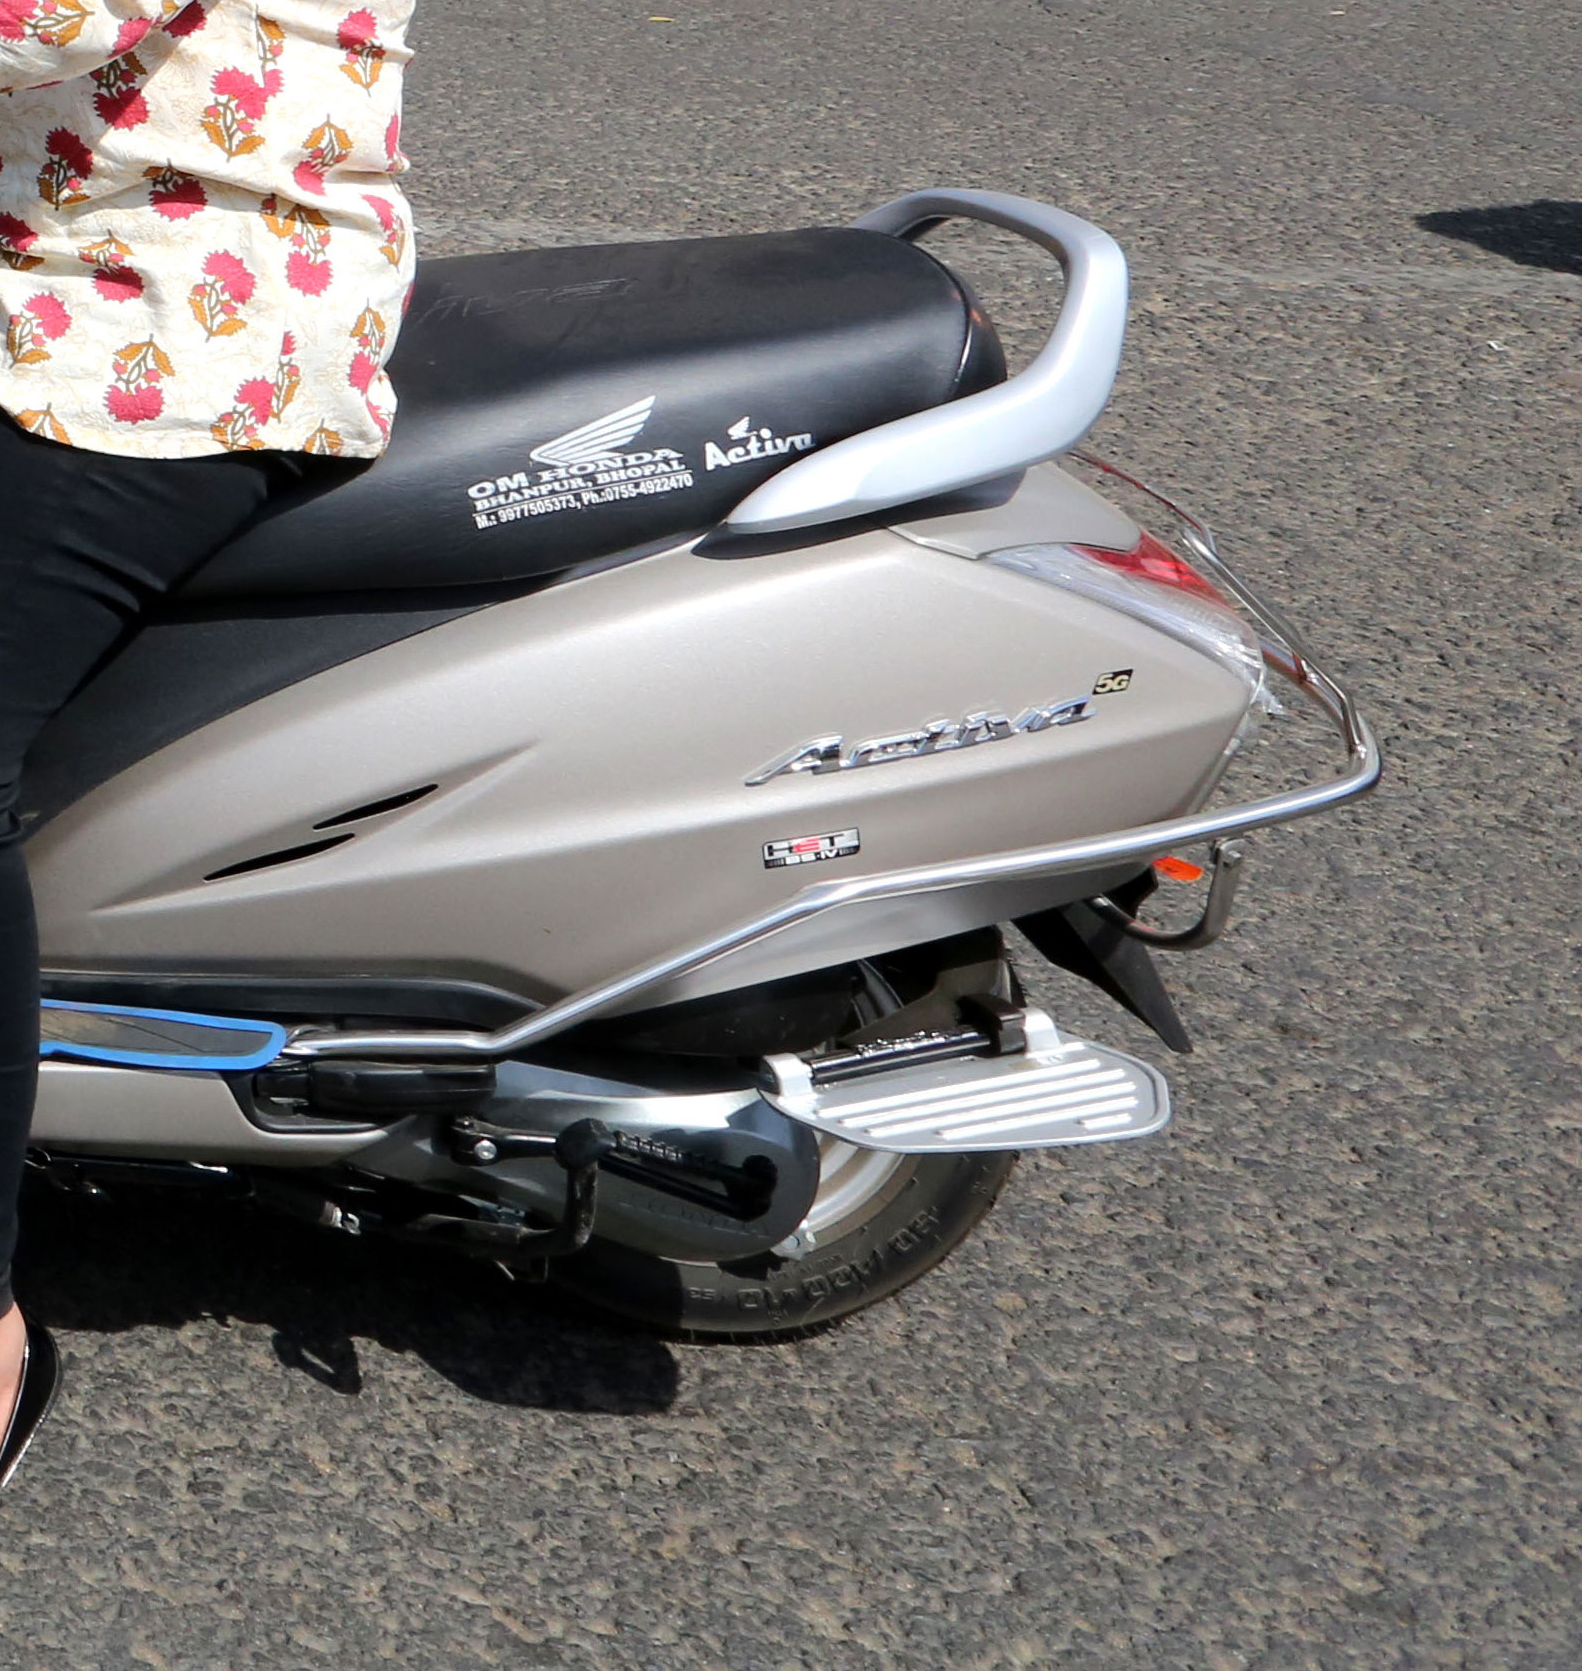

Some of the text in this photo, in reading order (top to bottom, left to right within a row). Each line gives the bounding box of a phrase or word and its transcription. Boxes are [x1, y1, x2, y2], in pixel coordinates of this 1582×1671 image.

[467, 448, 684, 499] OM HONDA
[704, 428, 815, 471] Activa
[474, 460, 686, 511] BHANPUR, BHOPAL
[1095, 673, 1130, 693] 5G
[745, 695, 1097, 786] Activa
